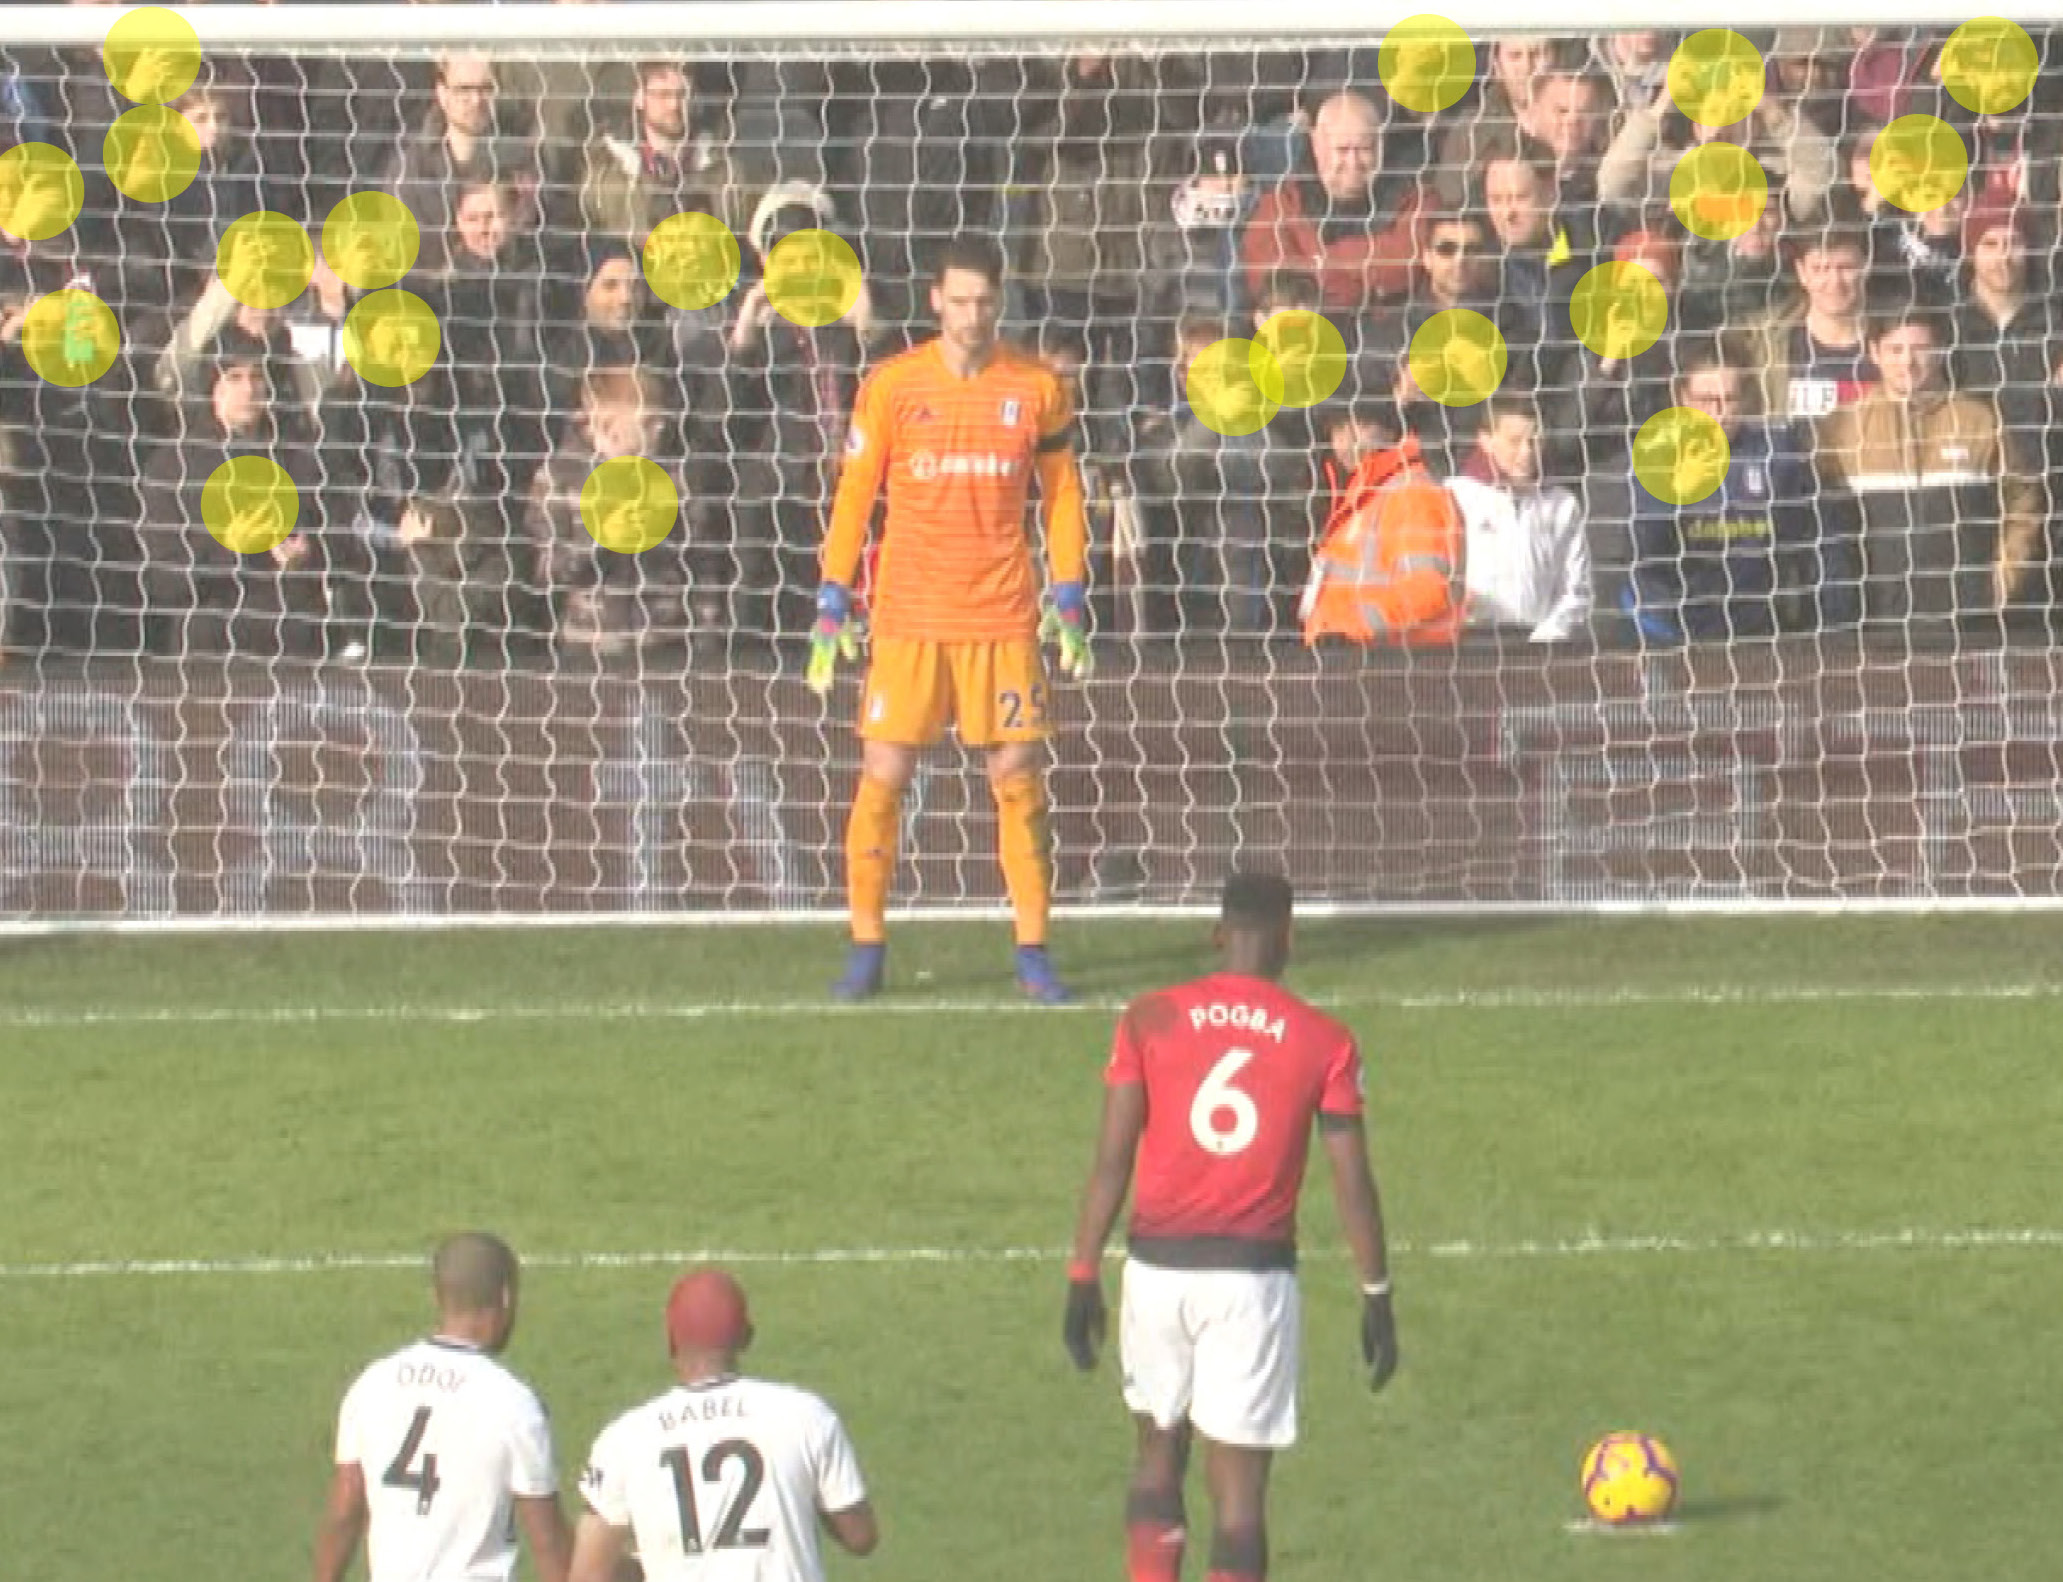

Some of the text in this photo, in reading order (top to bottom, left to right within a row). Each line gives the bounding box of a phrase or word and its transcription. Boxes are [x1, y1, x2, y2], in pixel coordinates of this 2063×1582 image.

[1188, 1003, 1286, 1044] POGBA
[1189, 1046, 1258, 1156] 6
[382, 1405, 440, 1516] 4
[658, 1395, 751, 1431] BABEL
[659, 1438, 770, 1556] 12
